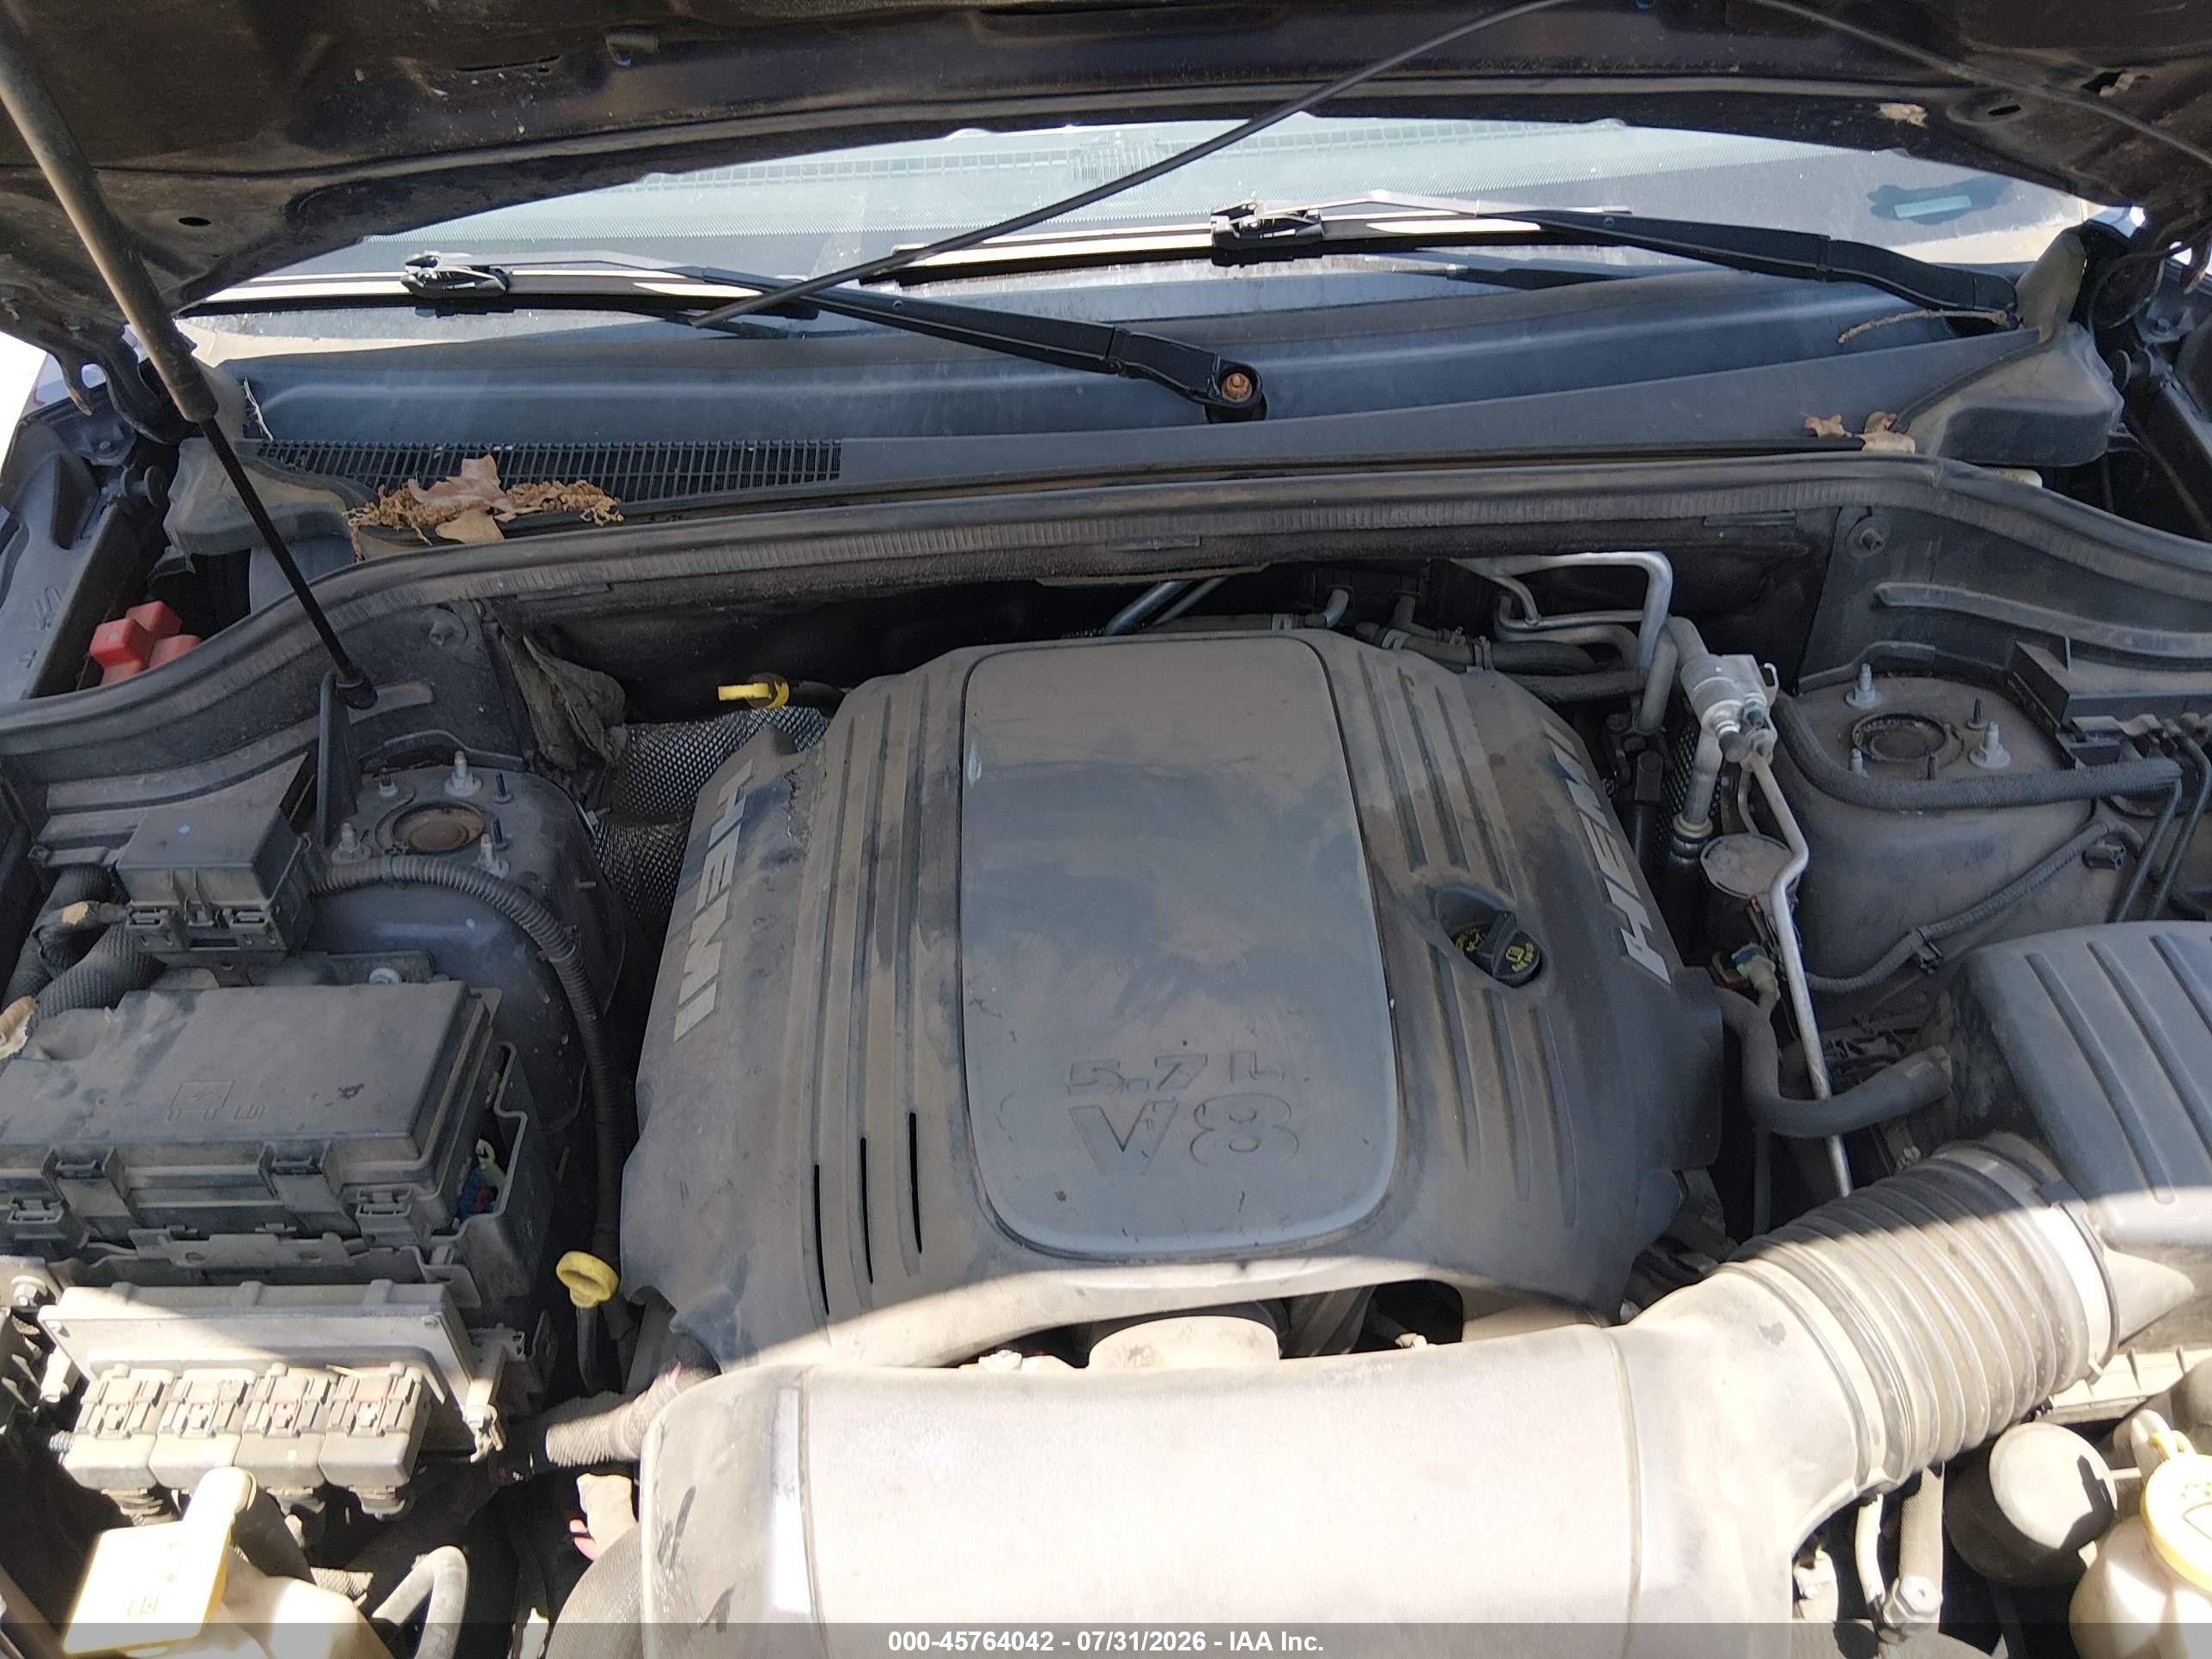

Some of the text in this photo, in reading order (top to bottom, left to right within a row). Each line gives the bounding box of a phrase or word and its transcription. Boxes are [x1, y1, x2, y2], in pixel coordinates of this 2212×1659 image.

[673, 757, 753, 1042] HEMI
[1540, 717, 1671, 985] HEMI
[1067, 1092, 1300, 1176] V8
